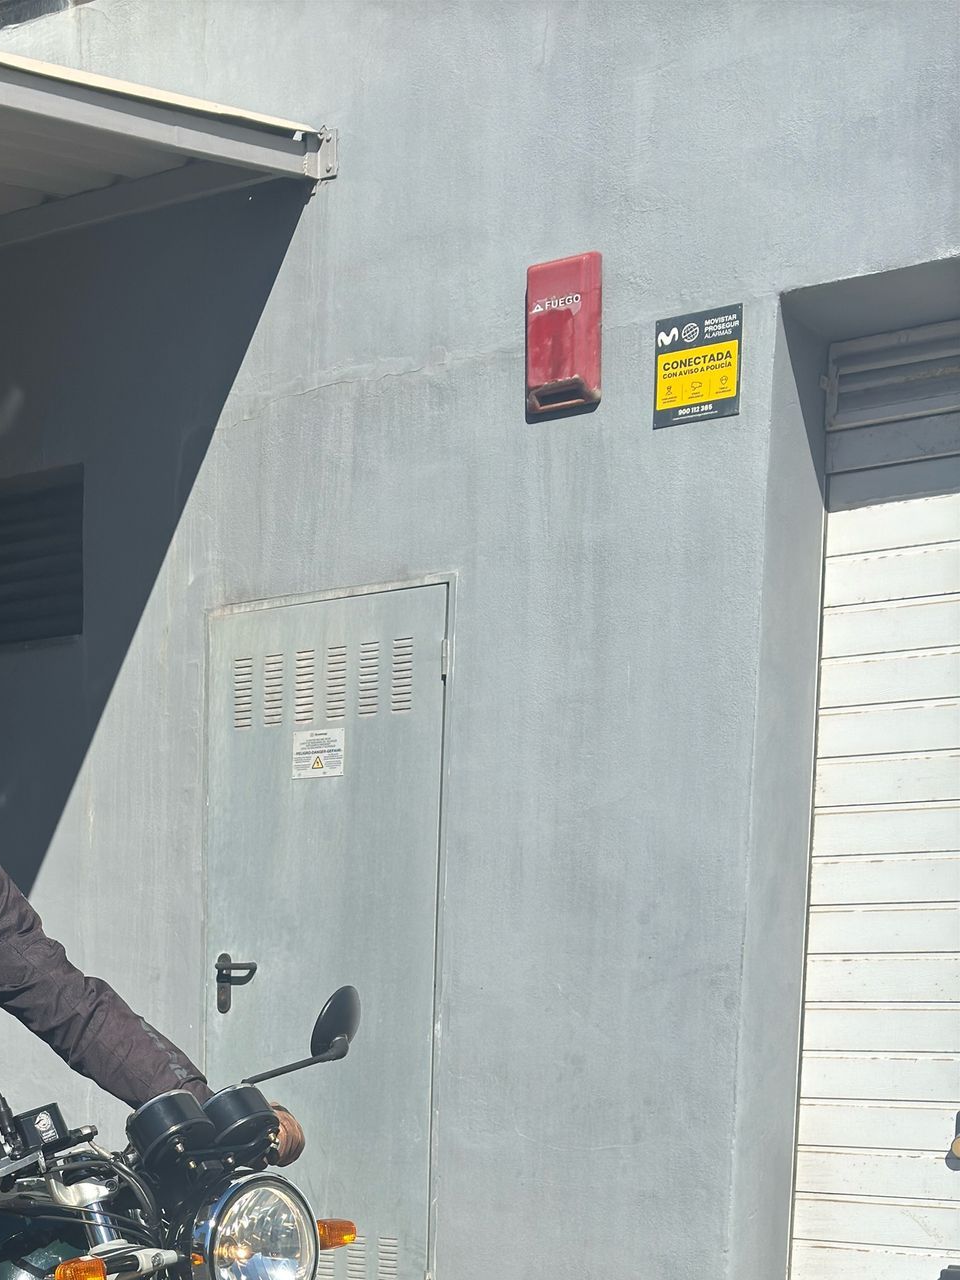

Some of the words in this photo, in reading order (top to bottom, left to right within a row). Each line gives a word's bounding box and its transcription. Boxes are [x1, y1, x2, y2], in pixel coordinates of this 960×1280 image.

[545, 293, 581, 310] FUEGO
[704, 314, 737, 326] MOVISTAR
[704, 320, 740, 333] PROSEGUR
[703, 329, 732, 339] ALARMAS
[663, 350, 732, 372] CONECTADA
[662, 371, 677, 379] CON
[678, 367, 699, 377] AVISO
